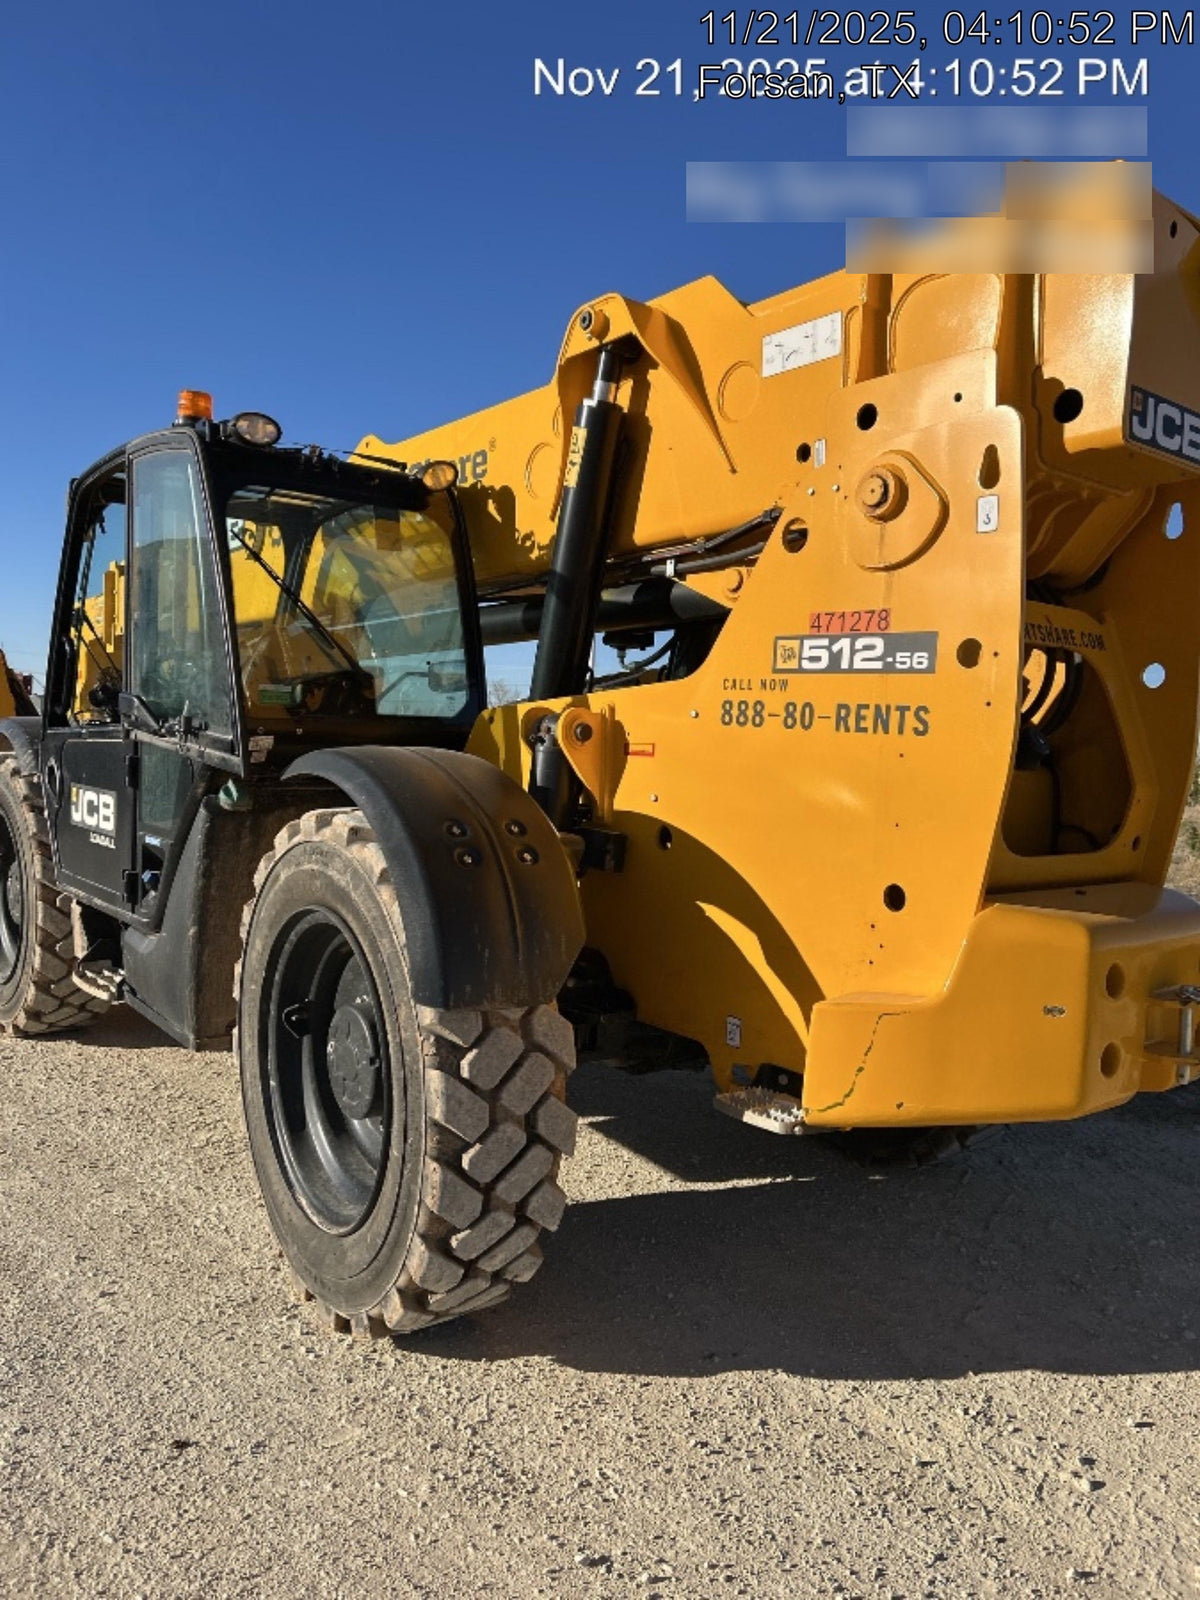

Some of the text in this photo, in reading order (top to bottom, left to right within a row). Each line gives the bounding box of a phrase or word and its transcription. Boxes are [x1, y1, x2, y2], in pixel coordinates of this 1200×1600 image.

[810, 609, 890, 633] 471278
[801, 636, 929, 670] 512-56
[723, 679, 789, 692] CALL NOW
[721, 699, 930, 737] 888-80-RENTS
[71, 787, 115, 831] JCB
